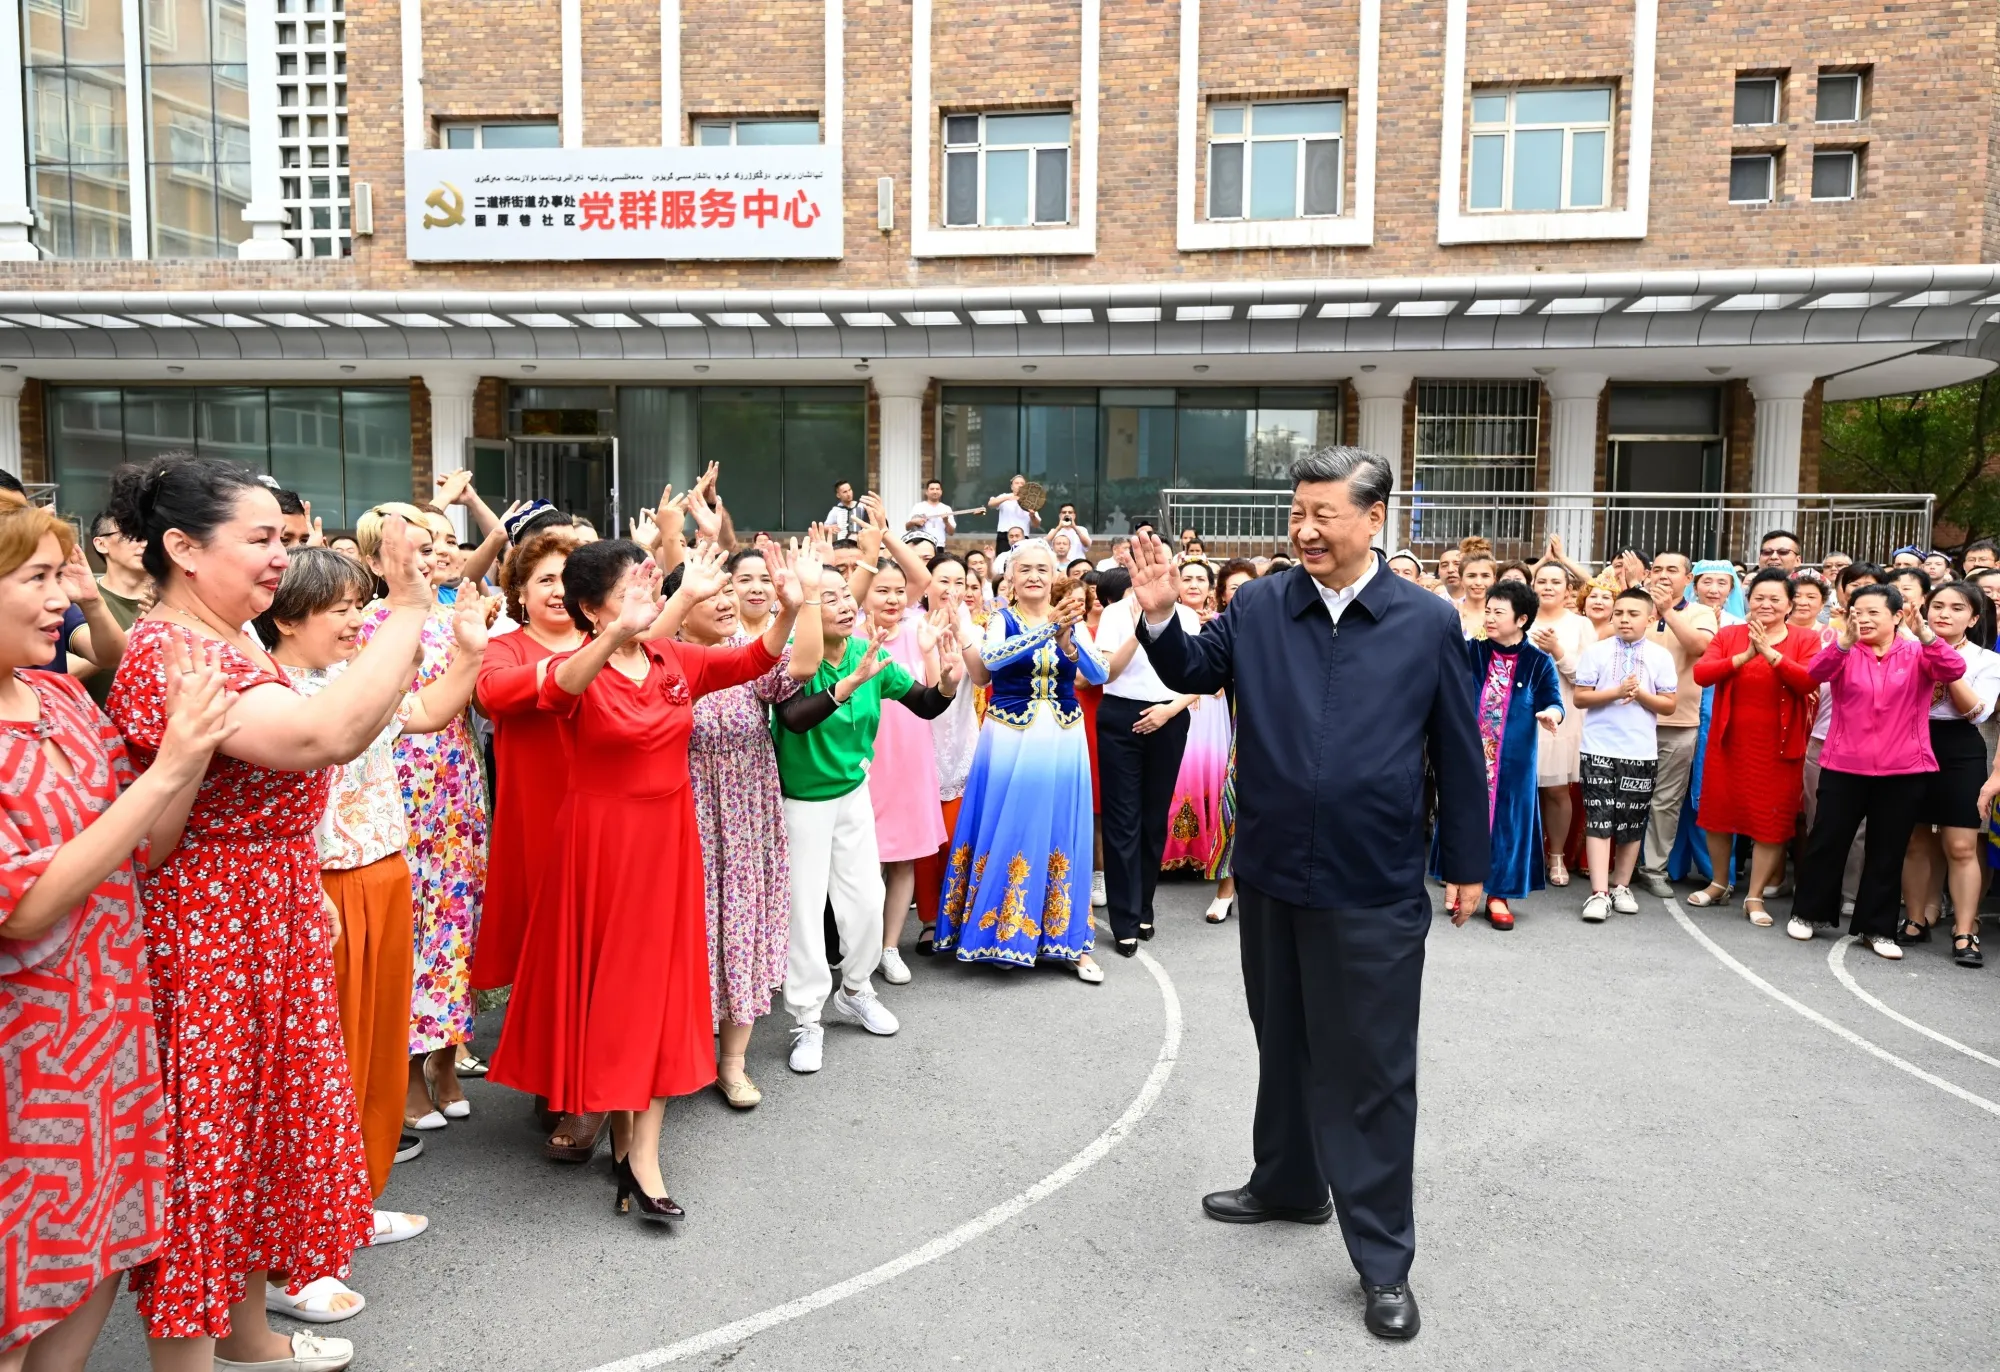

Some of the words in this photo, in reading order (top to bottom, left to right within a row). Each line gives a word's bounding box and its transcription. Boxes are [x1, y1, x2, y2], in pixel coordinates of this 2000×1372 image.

[474, 194, 576, 209] 二道桥街道办事处
[578, 187, 821, 230] 党群服务中心
